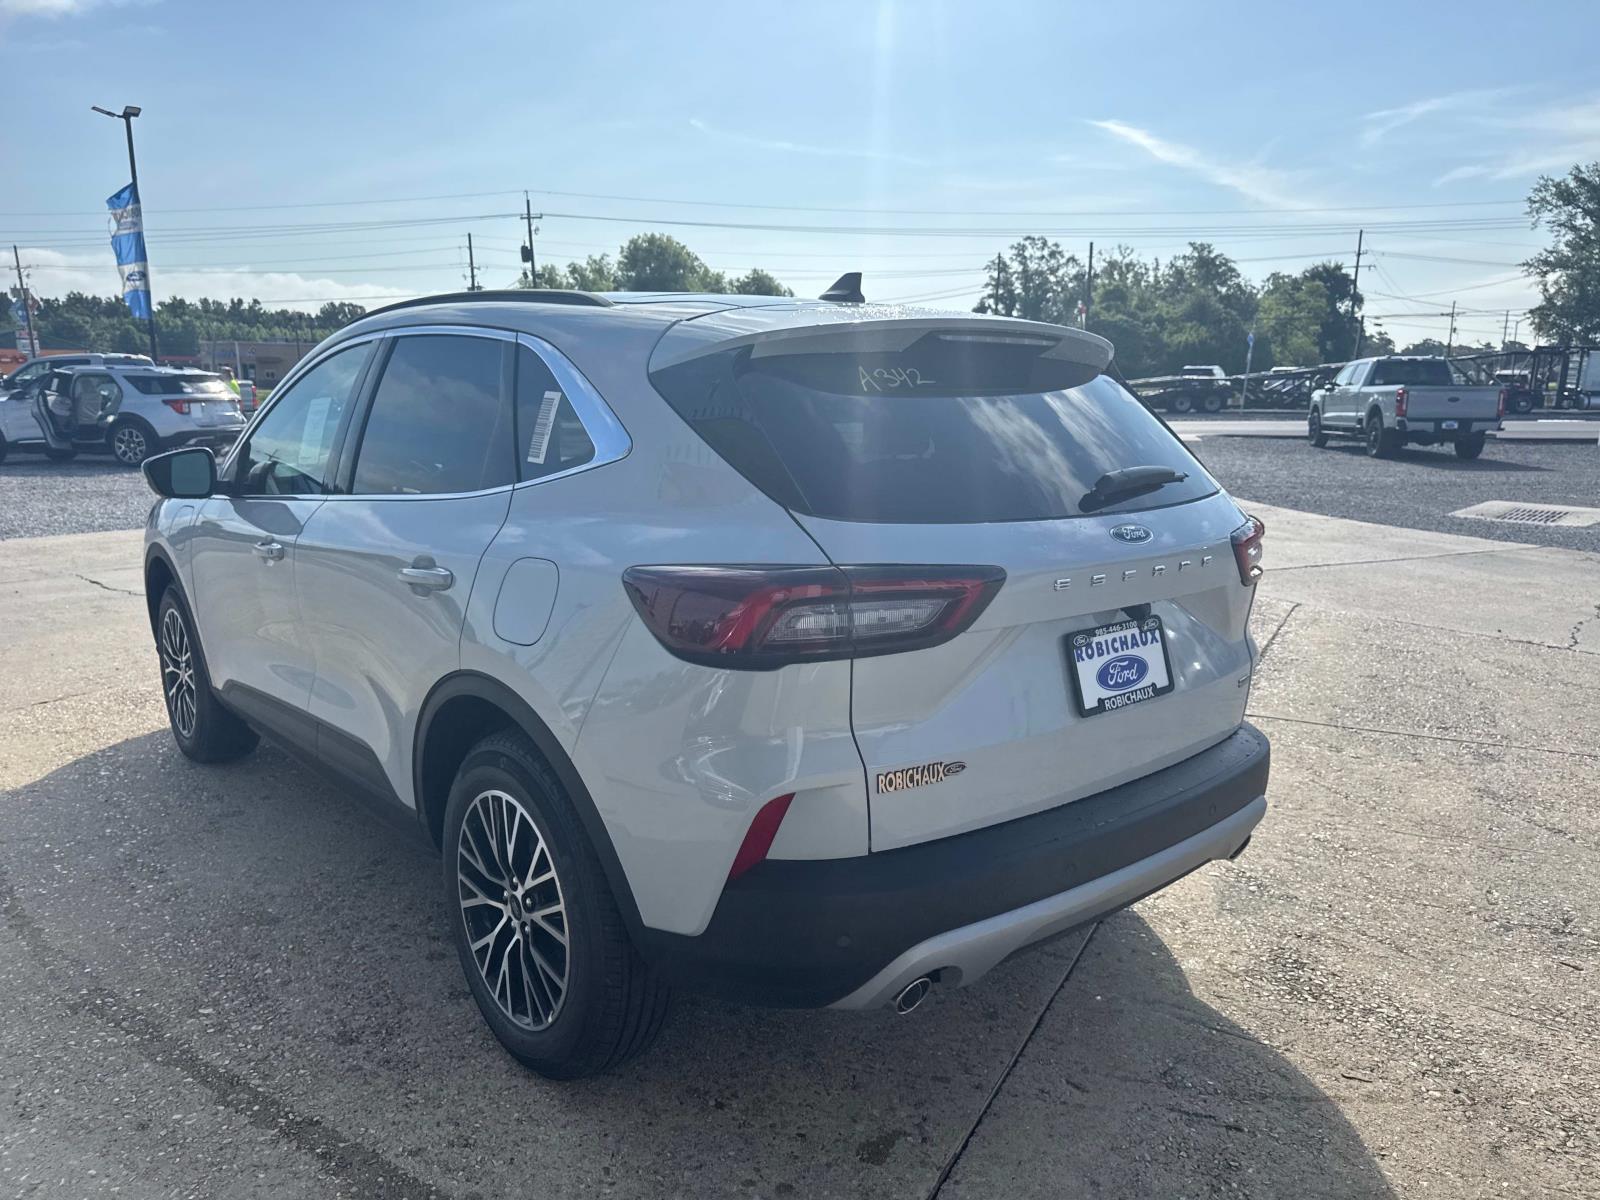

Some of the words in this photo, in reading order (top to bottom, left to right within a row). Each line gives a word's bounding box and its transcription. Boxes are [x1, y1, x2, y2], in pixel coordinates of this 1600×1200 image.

[1122, 525, 1147, 539] Ford
[1074, 631, 1160, 663] ROBICHAUX
[1107, 660, 1139, 686] Ford
[1104, 686, 1155, 710] ROBICHAUX
[877, 762, 945, 794] ROBICHAUX
